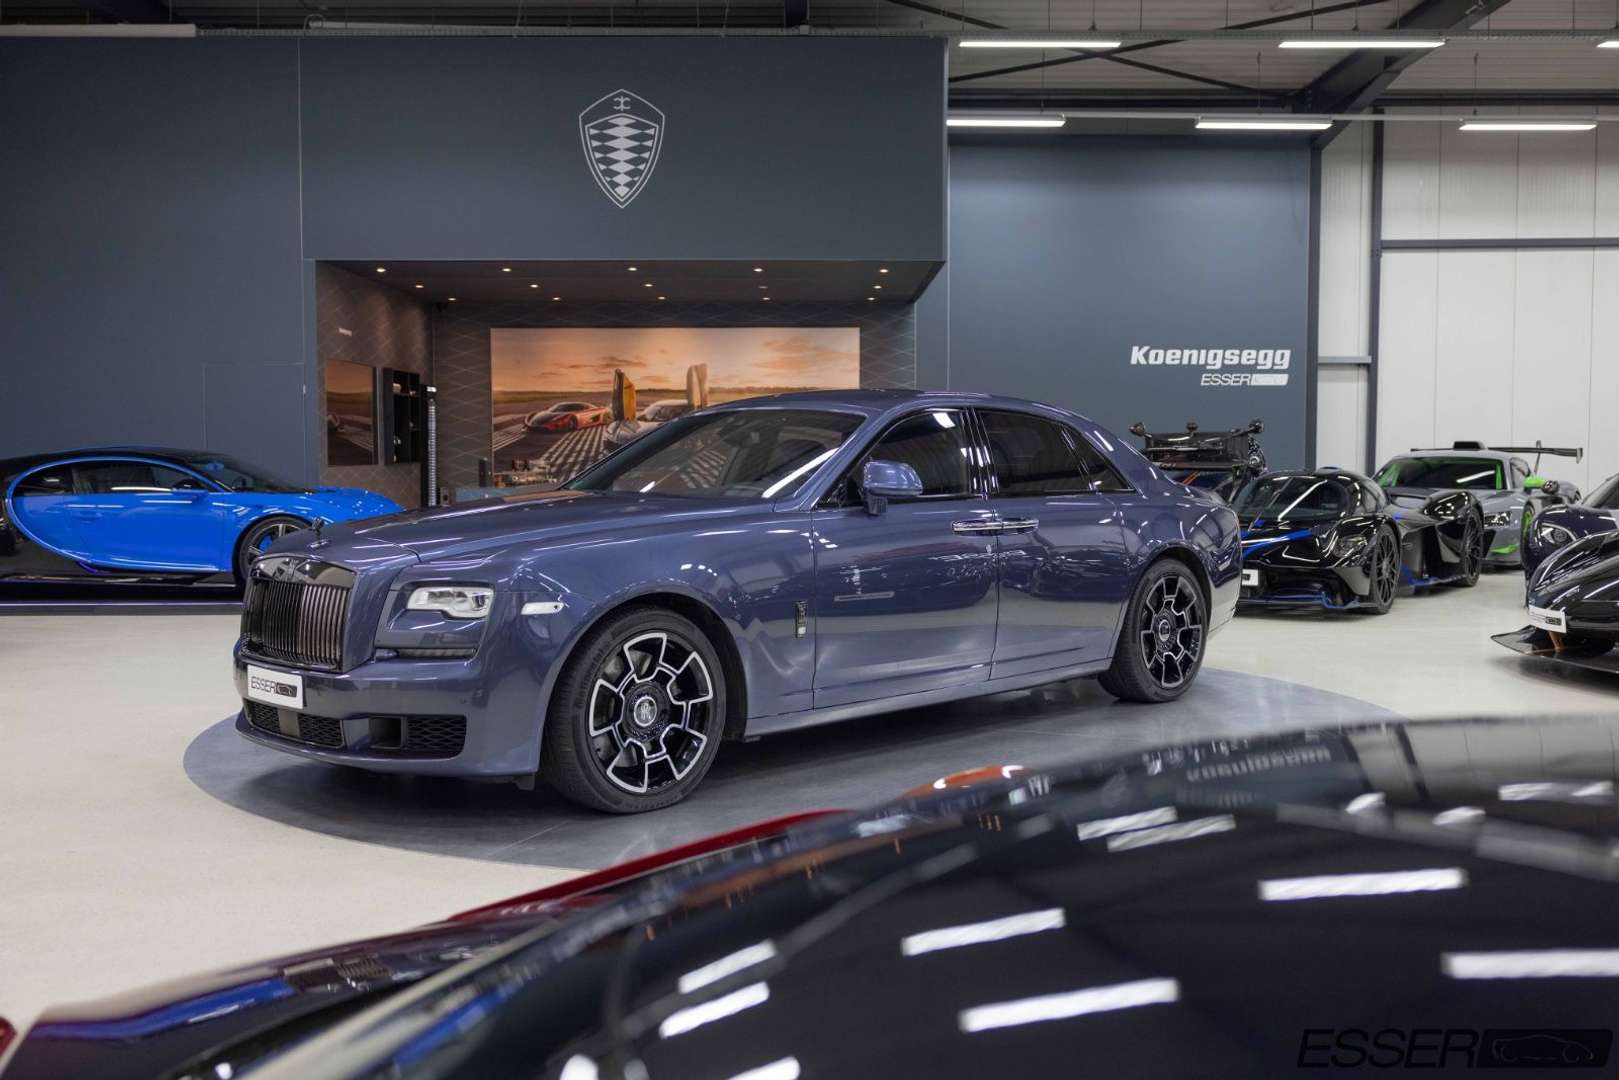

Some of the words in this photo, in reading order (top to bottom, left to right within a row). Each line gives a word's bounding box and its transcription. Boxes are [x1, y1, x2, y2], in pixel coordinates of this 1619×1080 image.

[1130, 346, 1291, 369] Koenigsegg
[1200, 374, 1250, 386] ESSER
[251, 676, 277, 694] ESSER
